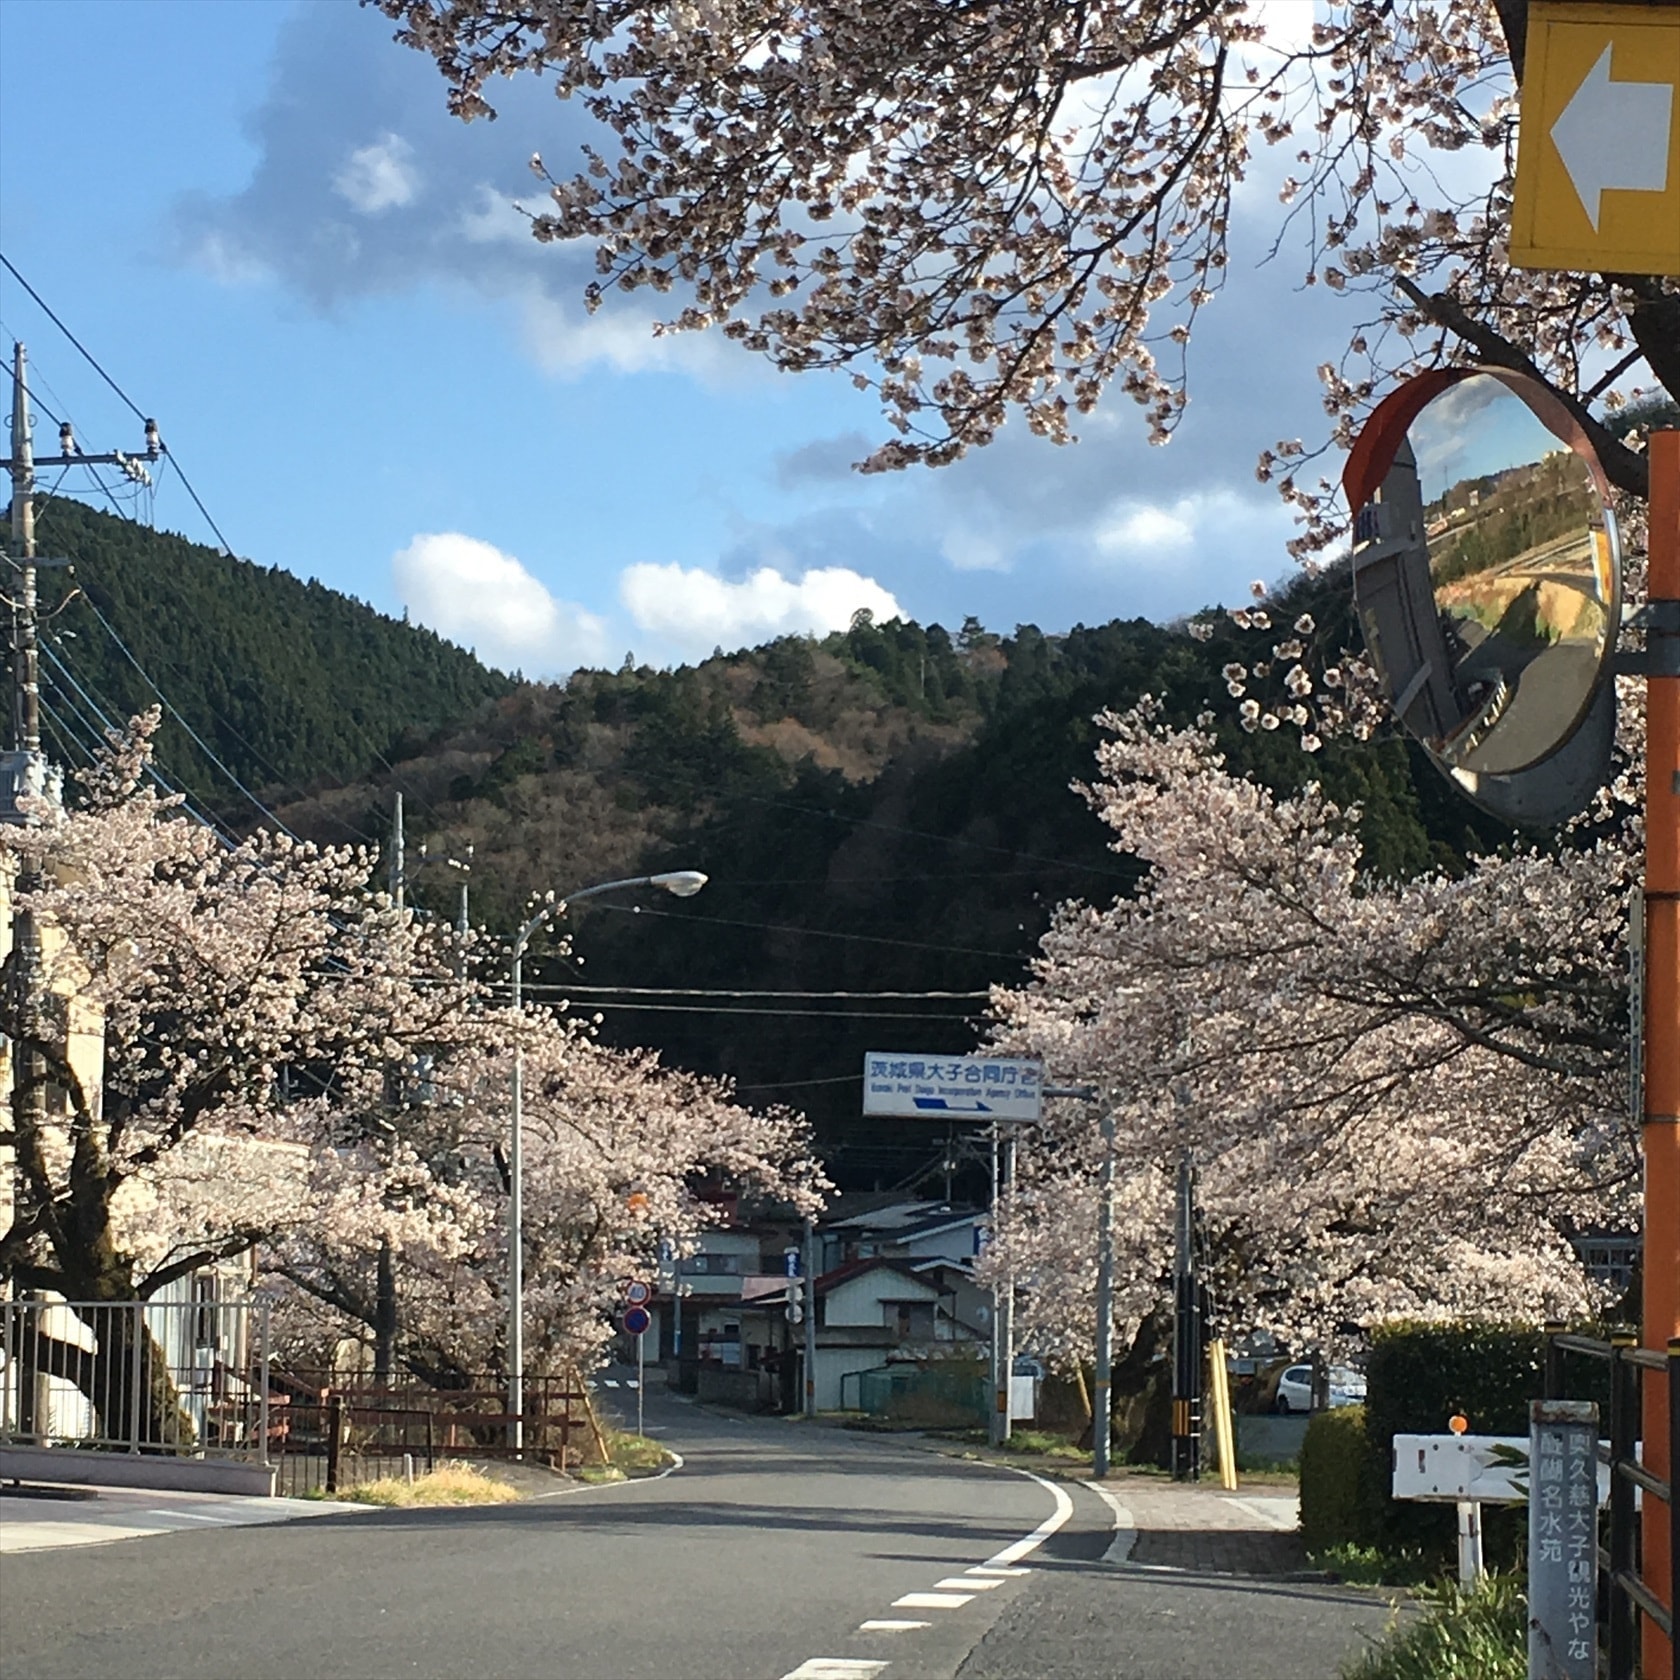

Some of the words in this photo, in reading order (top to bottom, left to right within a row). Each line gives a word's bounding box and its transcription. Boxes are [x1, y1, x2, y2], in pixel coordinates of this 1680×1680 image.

[1568, 1433, 1590, 1660] 奥久慈大子観光やな
